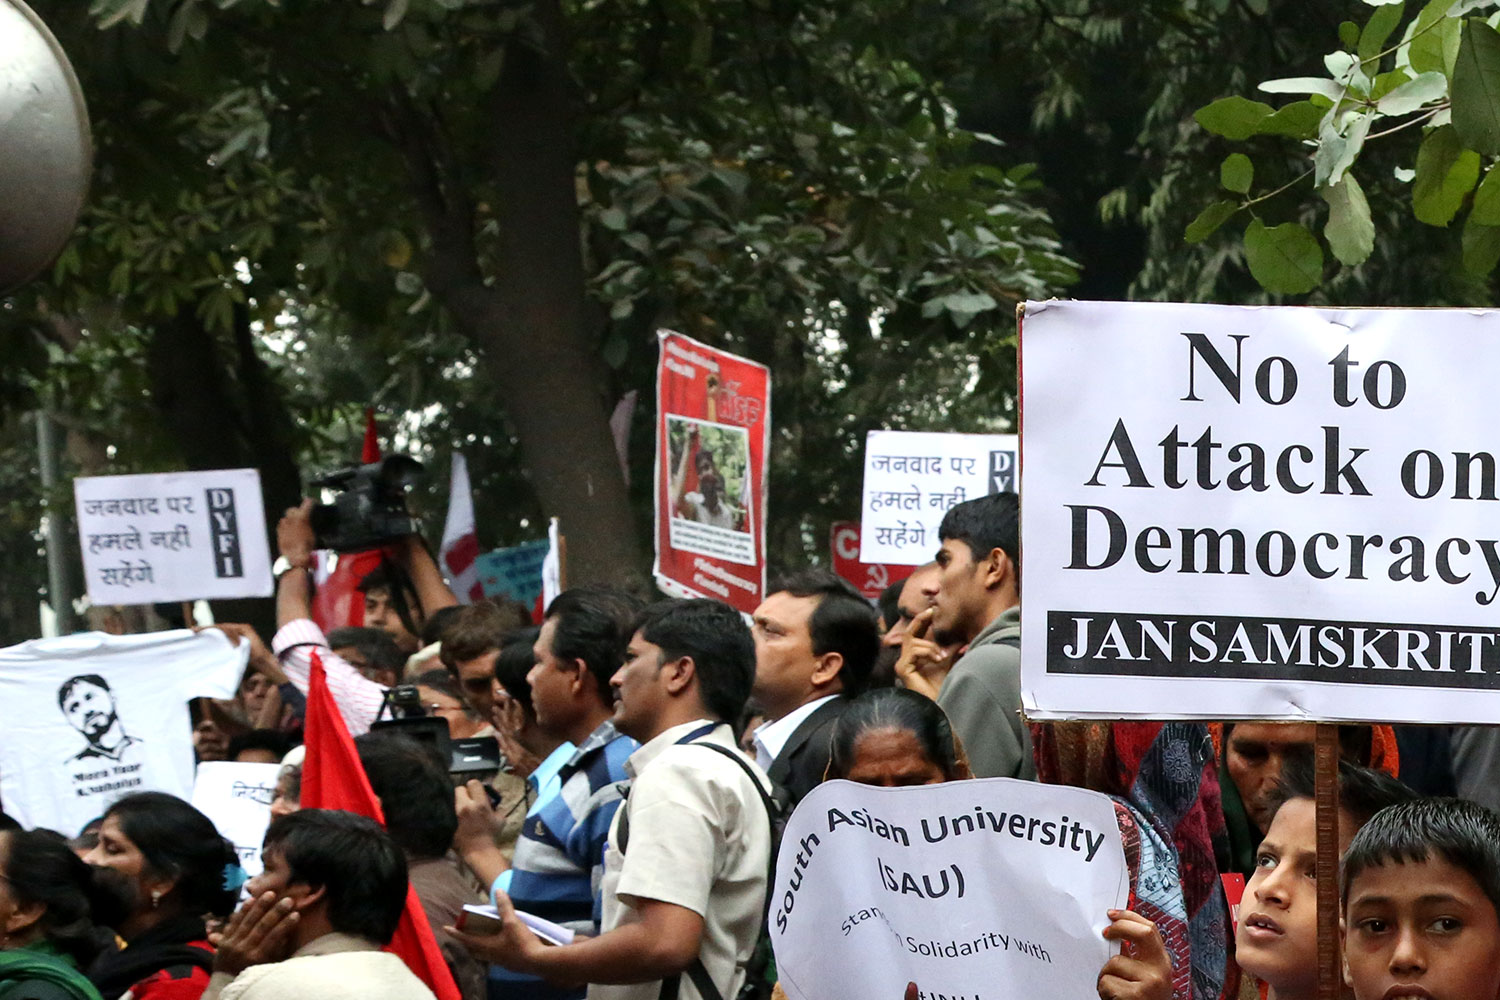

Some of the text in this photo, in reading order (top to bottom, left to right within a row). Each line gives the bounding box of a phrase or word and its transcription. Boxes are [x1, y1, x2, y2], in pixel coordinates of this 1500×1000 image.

[1181, 333, 1407, 410] No to
[870, 455, 977, 475] जनवाद पर
[993, 452, 1011, 493] DY
[1084, 418, 1500, 501] Attack on
[84, 496, 196, 516] जनवाद पर
[869, 484, 922, 512] हमले
[87, 525, 143, 555] हमले
[210, 489, 236, 577] DYFI
[874, 519, 926, 549] सहेंगे
[98, 559, 155, 588] सहेंगे
[1063, 617, 1178, 663] JAN
[776, 806, 1106, 936] South Asian University
[906, 932, 1011, 958] Solidarity
[1013, 938, 1052, 964] with
